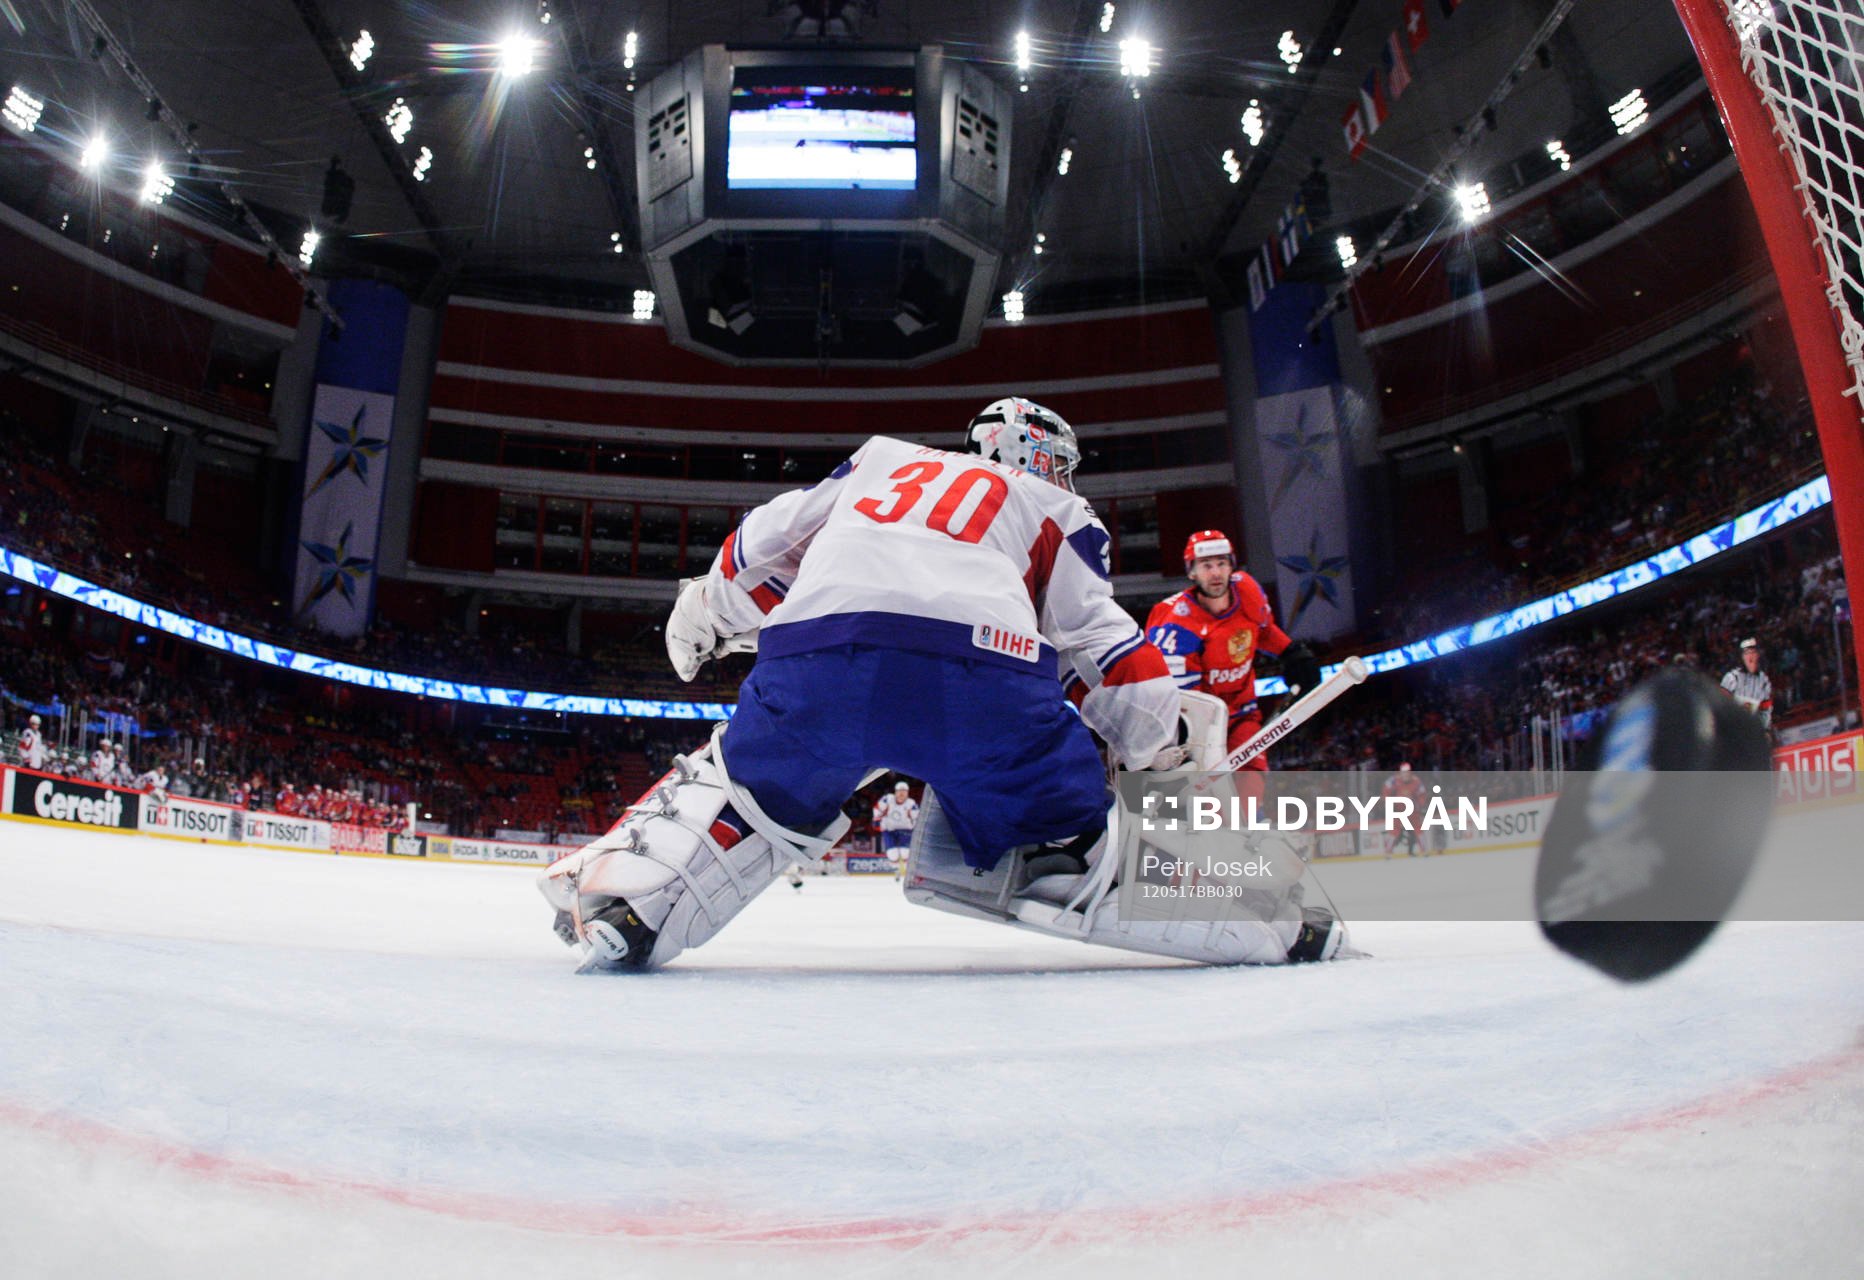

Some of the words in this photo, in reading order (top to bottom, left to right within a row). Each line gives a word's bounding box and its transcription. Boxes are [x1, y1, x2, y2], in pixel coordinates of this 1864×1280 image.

[854, 461, 1008, 544] 30
[993, 629, 1034, 657] IIHF
[34, 780, 123, 827] Ceresit
[172, 807, 227, 833] TISSOT
[266, 822, 309, 842] TISSOT
